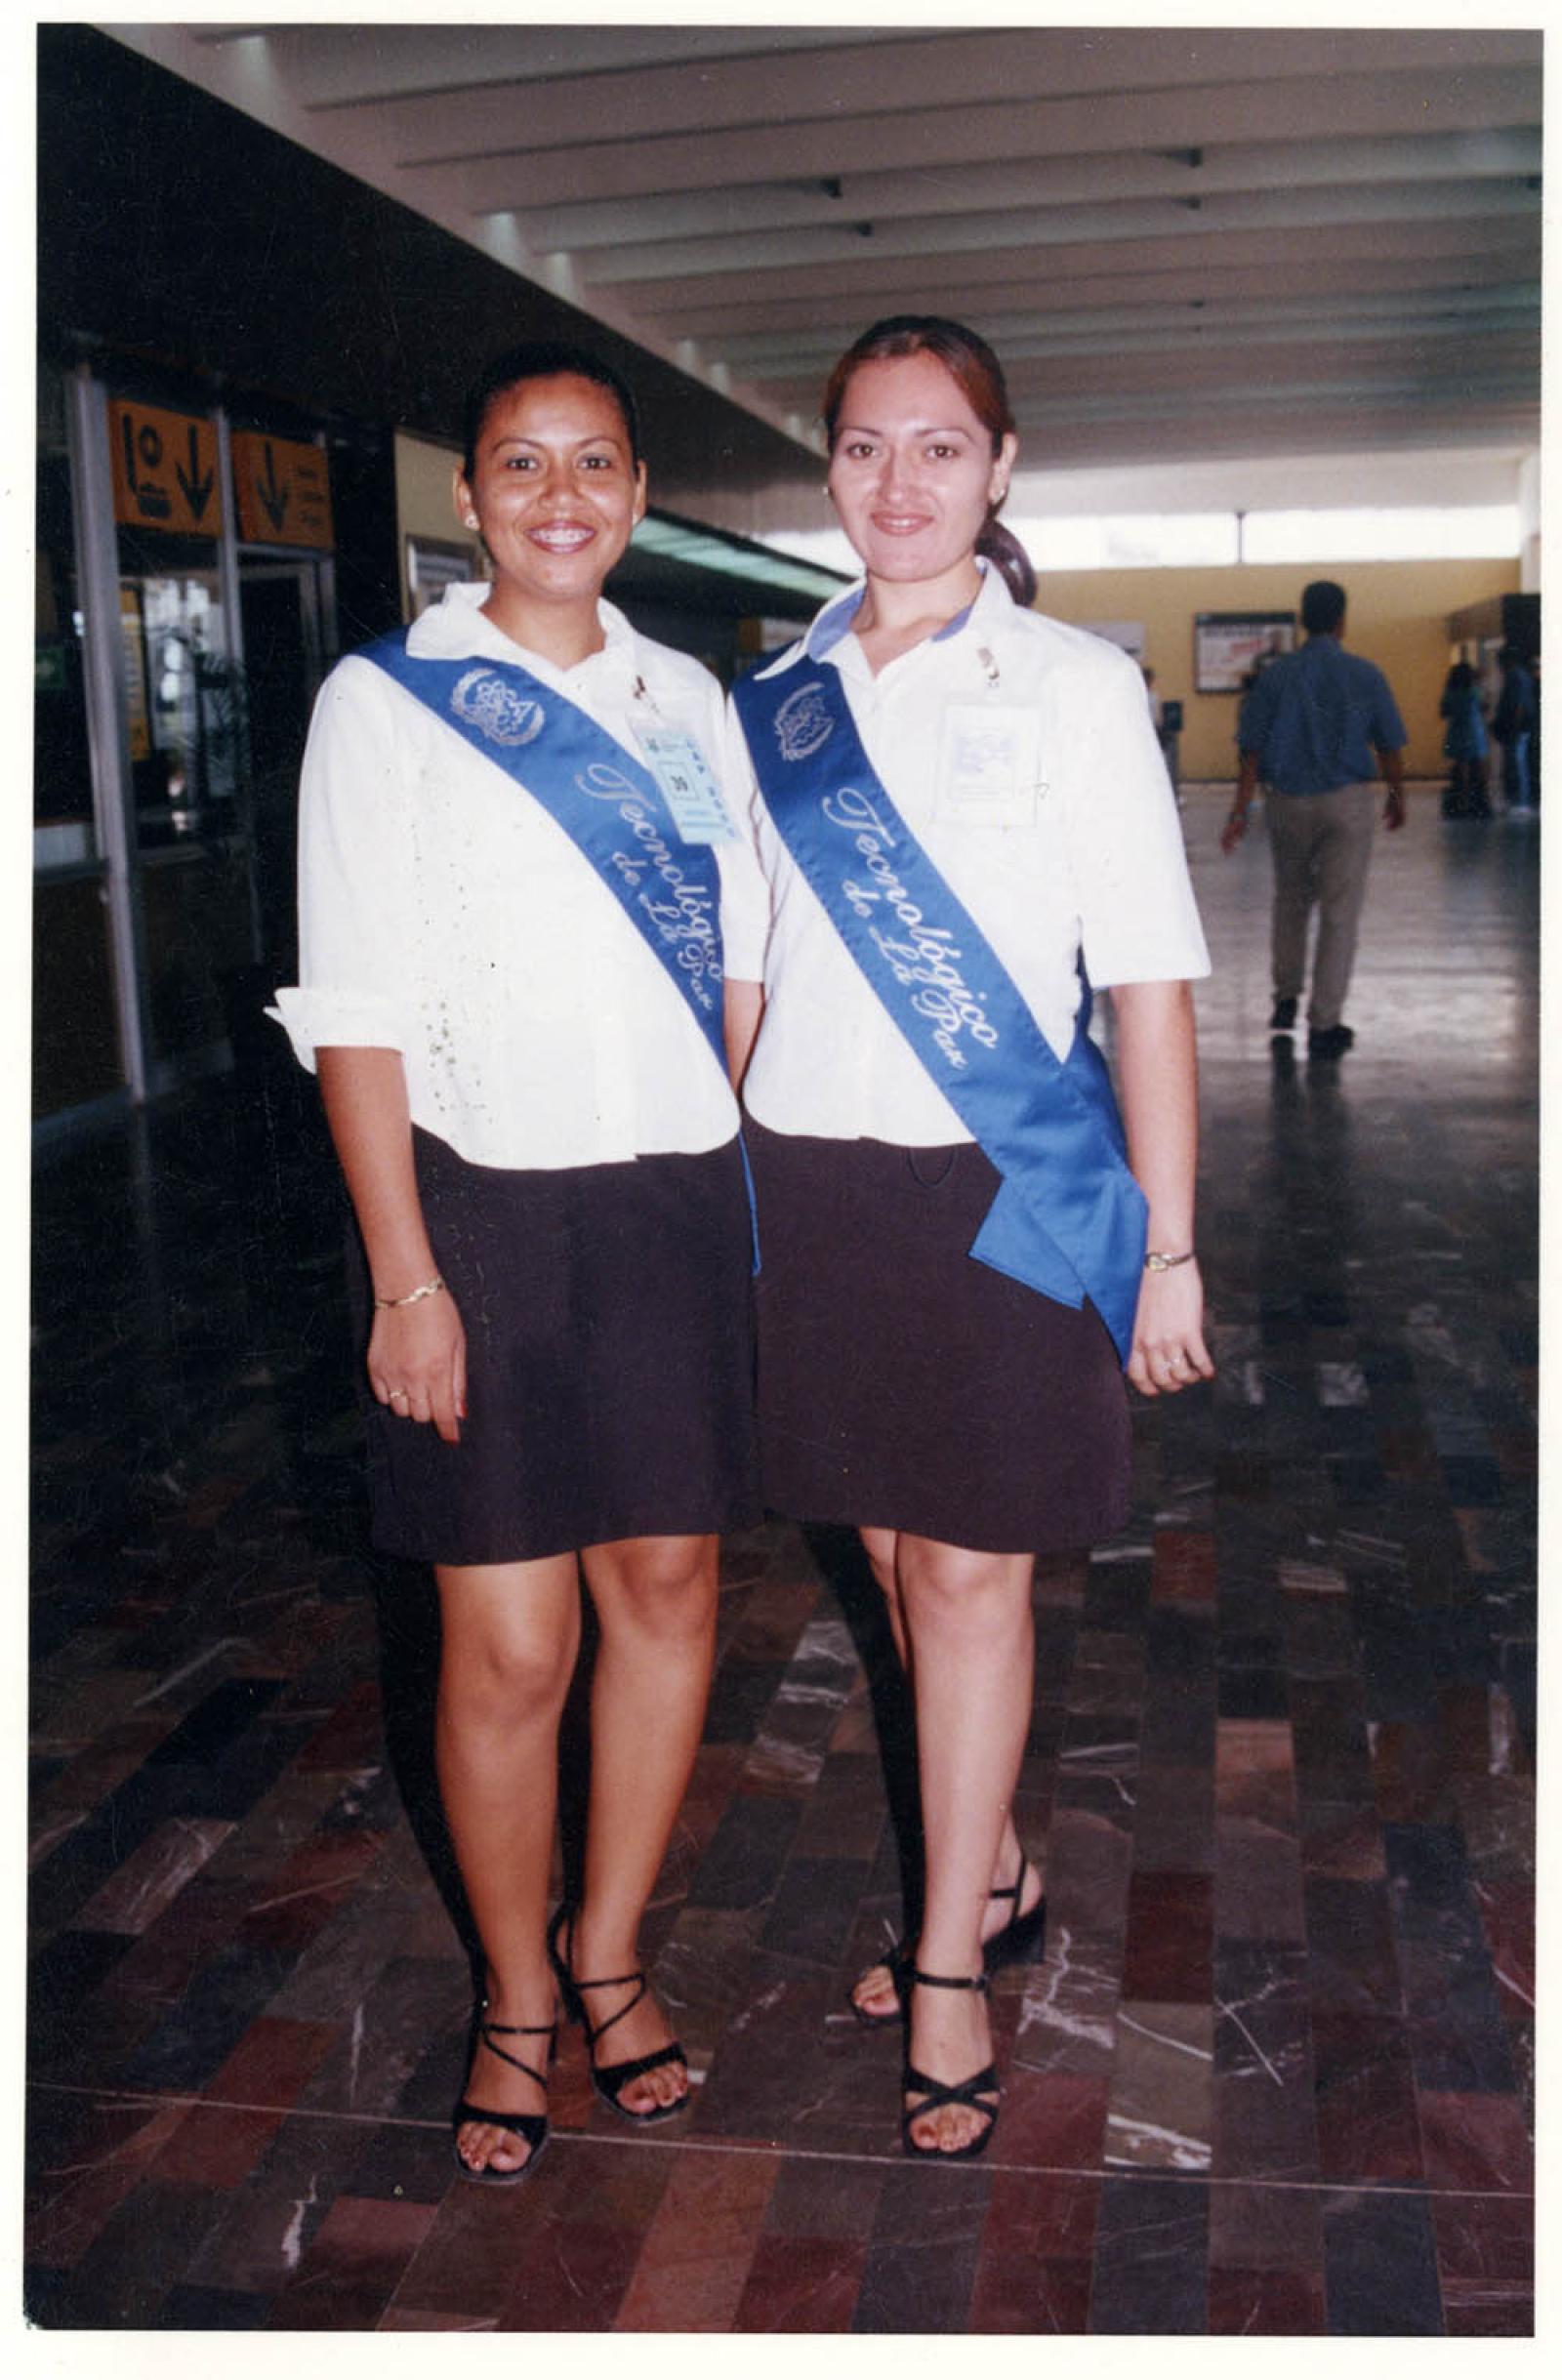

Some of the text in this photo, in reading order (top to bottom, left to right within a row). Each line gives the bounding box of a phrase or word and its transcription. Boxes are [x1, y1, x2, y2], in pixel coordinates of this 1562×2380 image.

[574, 762, 723, 982] Tecnológico
[611, 850, 648, 886] de
[637, 892, 681, 944] La
[821, 786, 999, 1049] Tecnológico
[841, 879, 882, 918] de
[868, 925, 921, 987] La
